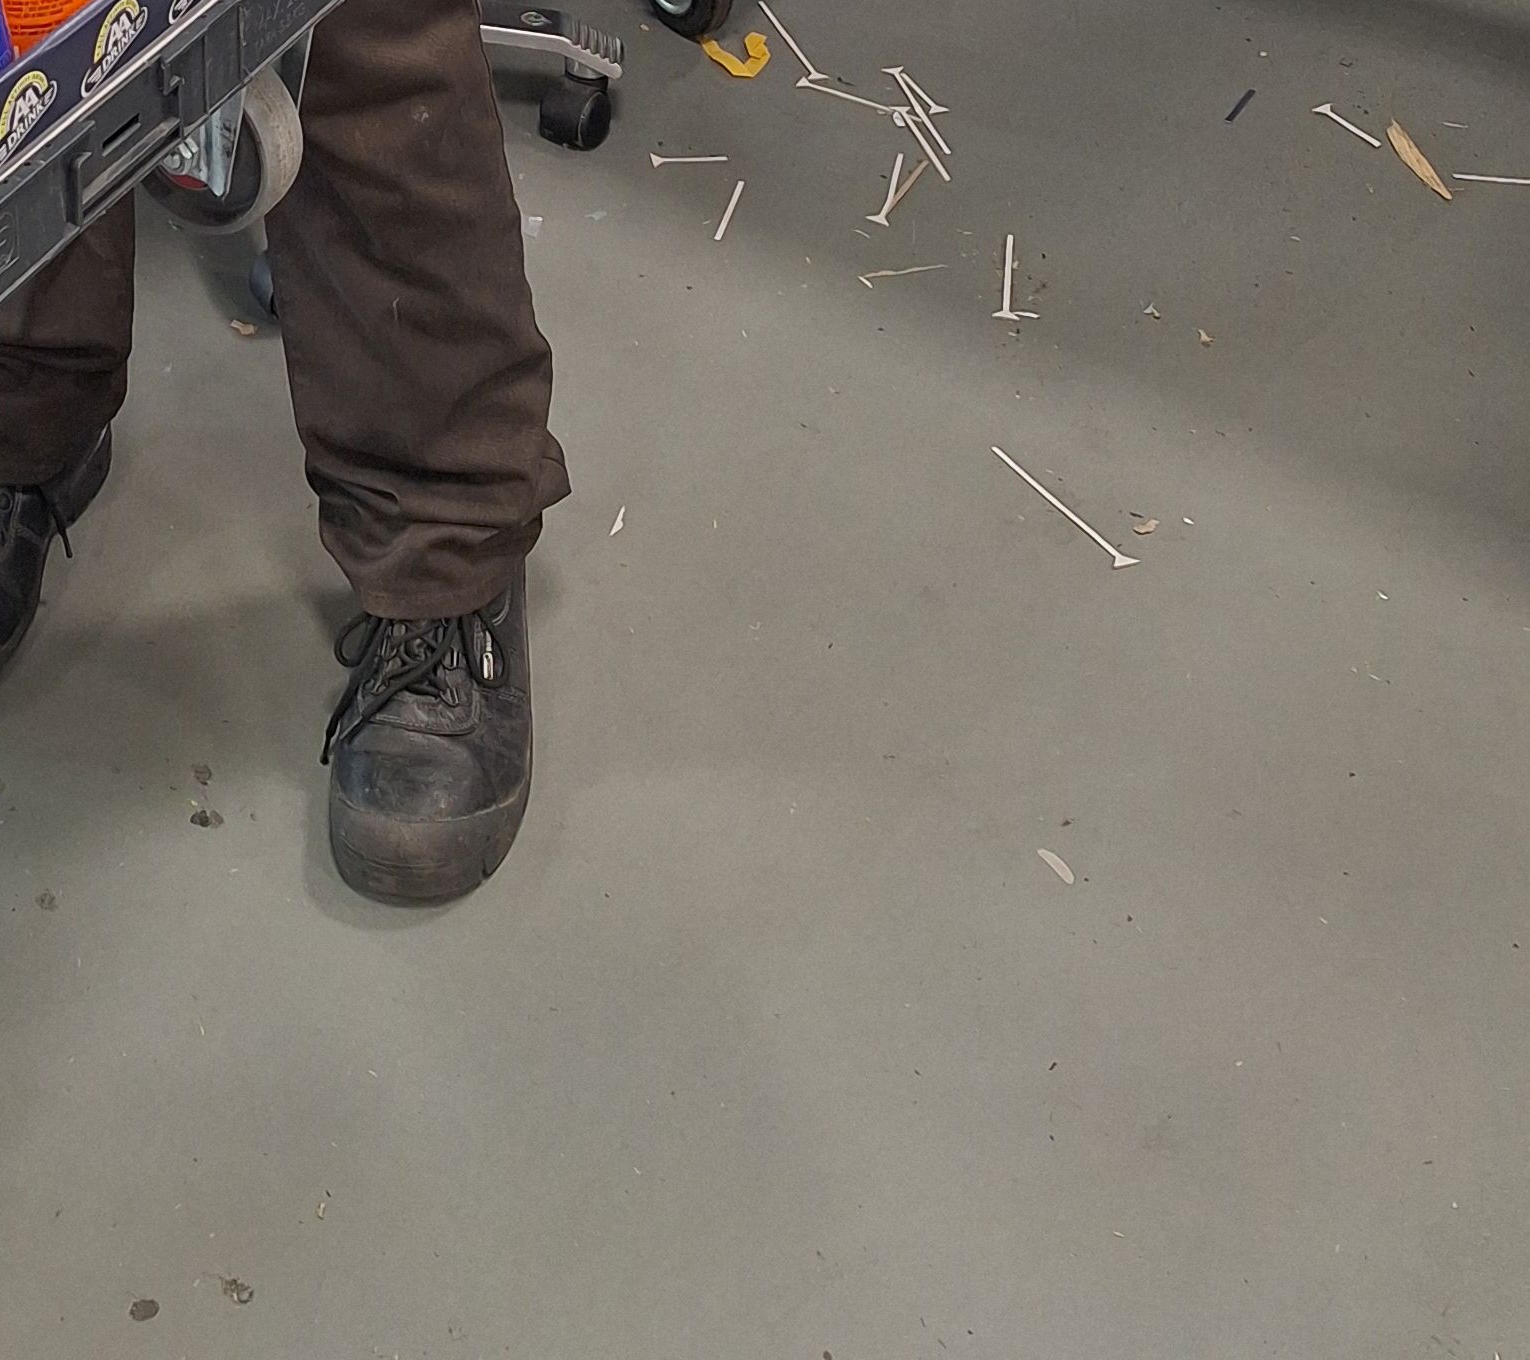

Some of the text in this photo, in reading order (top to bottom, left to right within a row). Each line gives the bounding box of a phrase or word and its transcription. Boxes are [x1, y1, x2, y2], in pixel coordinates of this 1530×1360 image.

[102, 26, 137, 74] DRINK
[107, 12, 132, 53] AA
[7, 100, 47, 151] DRINK
[12, 86, 39, 130] AA
